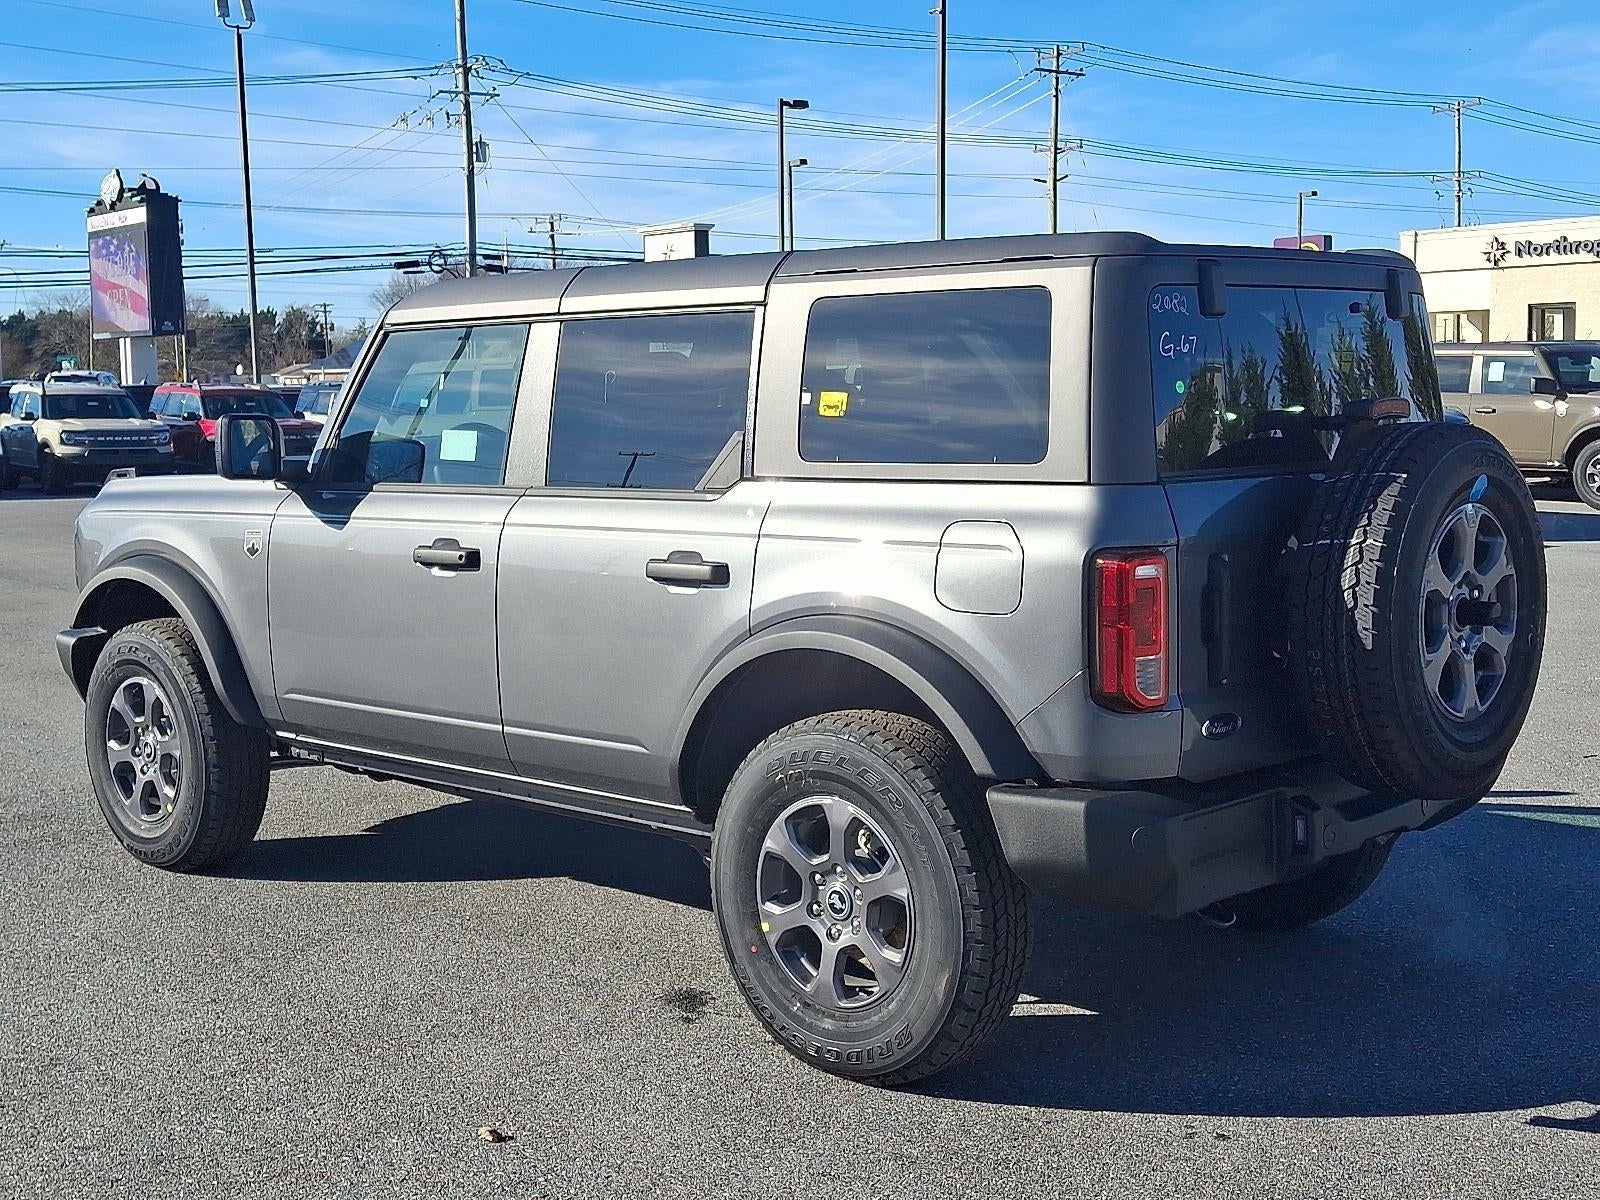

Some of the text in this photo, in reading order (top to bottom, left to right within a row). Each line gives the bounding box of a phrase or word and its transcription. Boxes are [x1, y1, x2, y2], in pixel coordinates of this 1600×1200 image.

[1160, 331, 1197, 359] G-67
[765, 749, 906, 812] DUELER
[734, 962, 914, 1066] BRIDGESTONE
